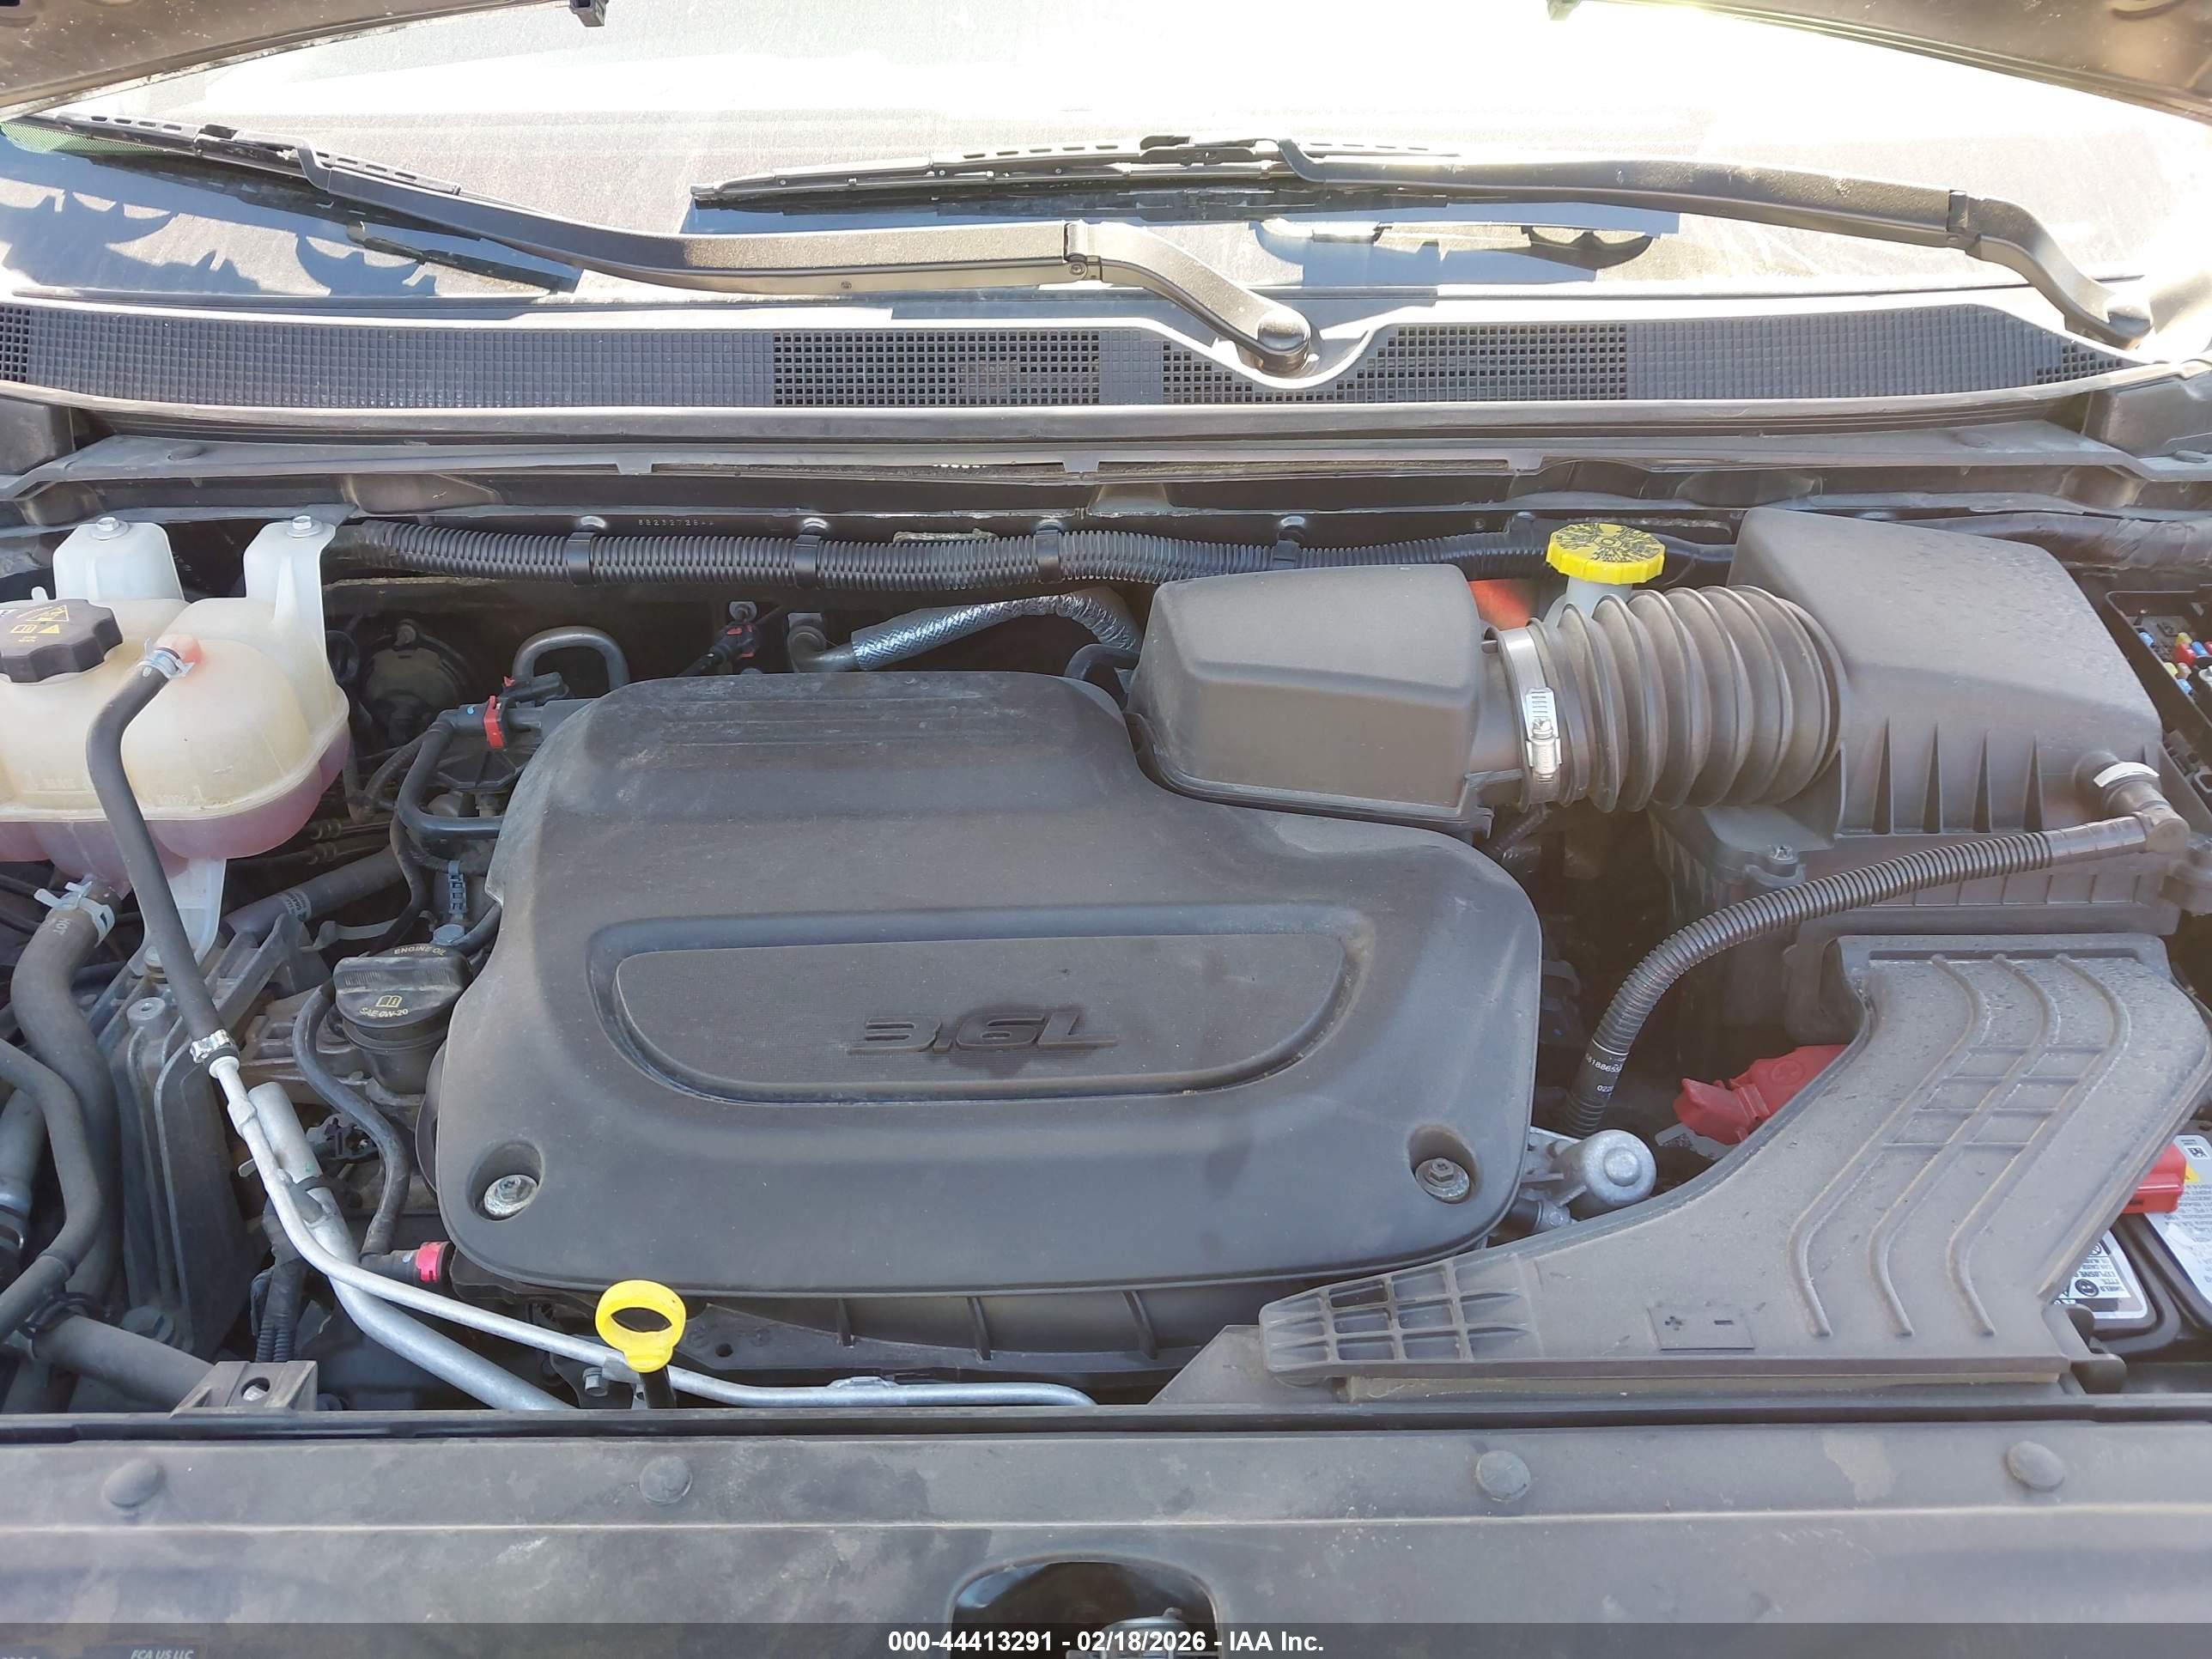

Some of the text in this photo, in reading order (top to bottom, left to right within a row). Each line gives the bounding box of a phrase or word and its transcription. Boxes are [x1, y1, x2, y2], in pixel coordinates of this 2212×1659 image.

[393, 945, 447, 957] ENGINE OIL
[359, 1007, 378, 1018] SAE
[847, 1004, 1119, 1054] 3.6L
[155, 1649, 173, 1659] US
